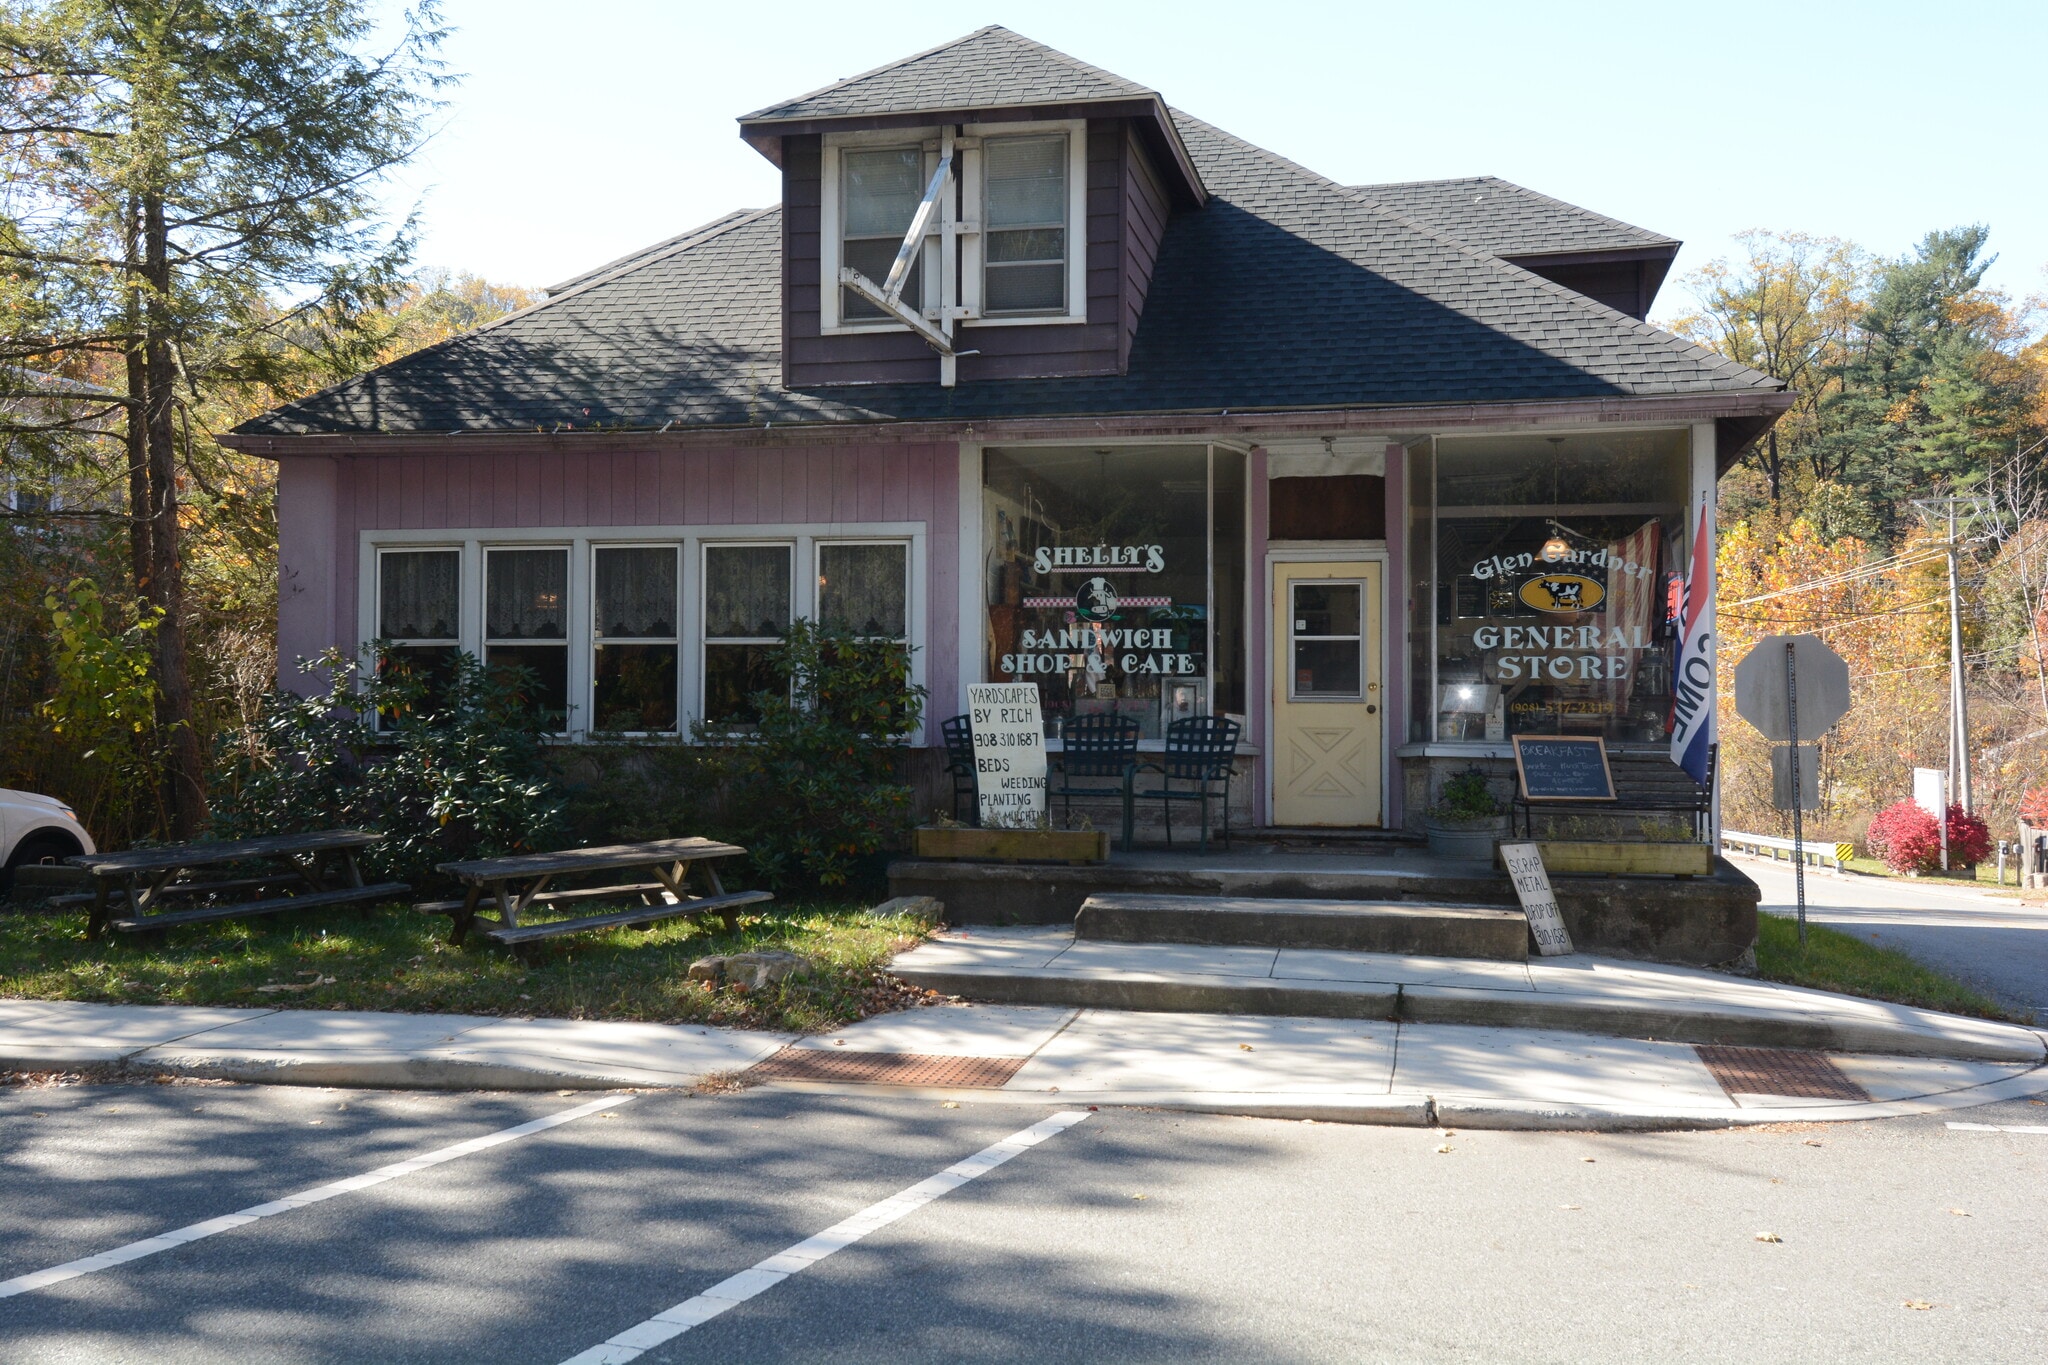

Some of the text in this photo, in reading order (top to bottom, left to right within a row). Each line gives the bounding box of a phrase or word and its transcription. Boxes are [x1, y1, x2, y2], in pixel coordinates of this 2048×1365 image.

[1034, 544, 1165, 574] SHELLY'S
[1472, 545, 1653, 580] Glen Gardner
[1022, 628, 1172, 649] SANDWICH
[1473, 625, 1652, 650] GENERAL
[1001, 653, 1195, 674] SHOP & CAFE
[1497, 655, 1628, 680] STORE
[970, 687, 1038, 704] YARDSCAPES
[974, 708, 1033, 723] BY RICH
[1511, 703, 1540, 714] (908)
[975, 732, 1039, 747] 908 310 1687
[1520, 744, 1595, 757] BREAKFAST
[978, 758, 1010, 773] BEDS
[1001, 777, 1047, 789] WEEDING
[980, 793, 1031, 806] PLANTING
[1509, 856, 1540, 874] SCRAP
[1516, 876, 1548, 893] METAL
[1525, 902, 1560, 921] DROP OFF
